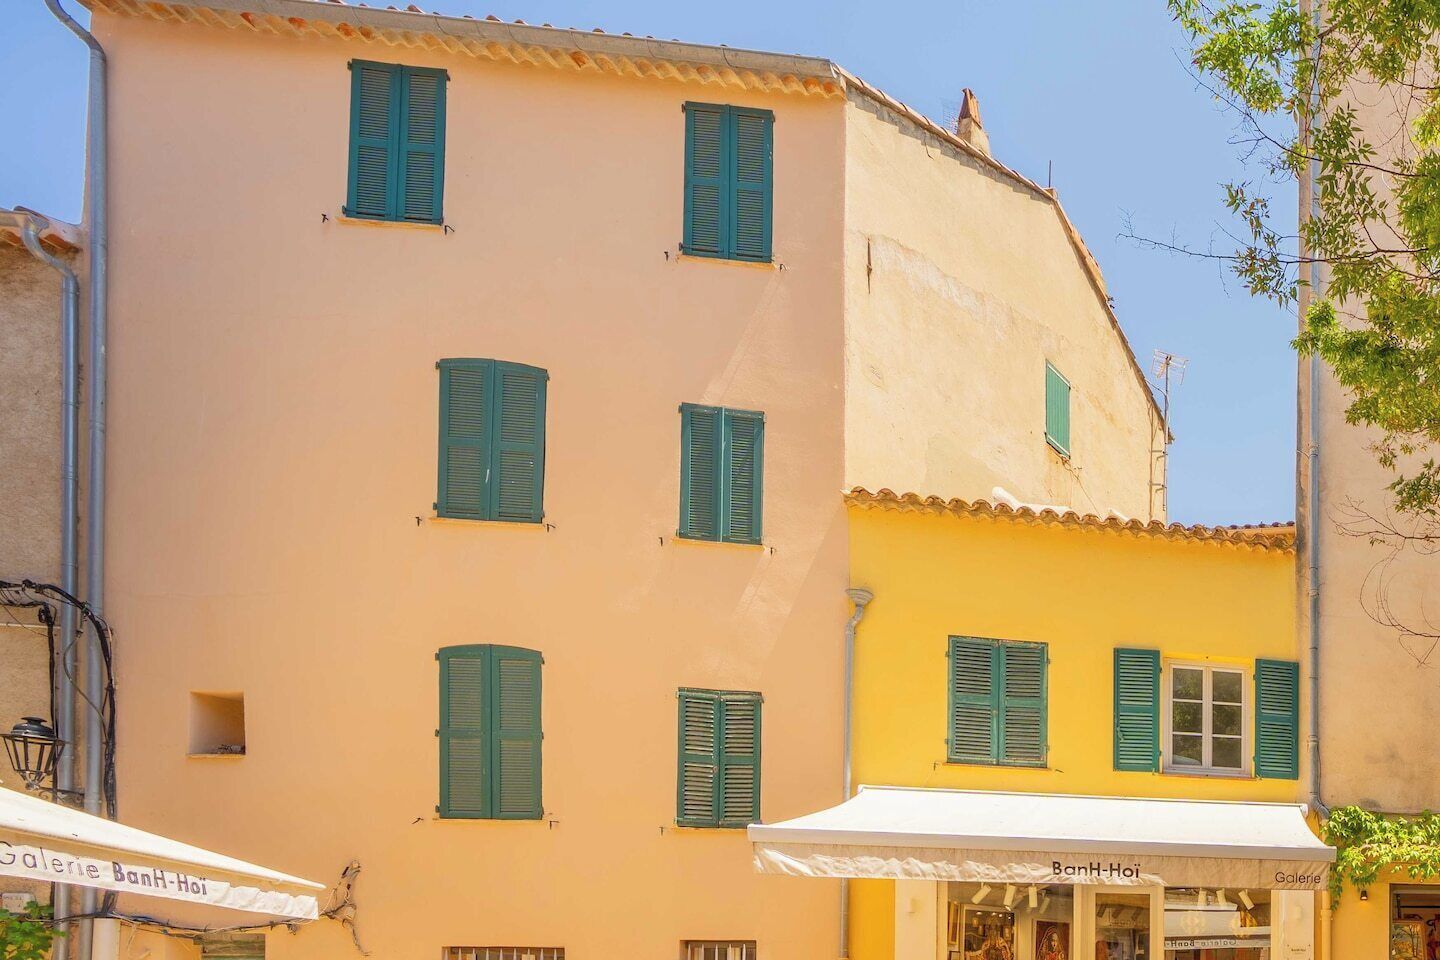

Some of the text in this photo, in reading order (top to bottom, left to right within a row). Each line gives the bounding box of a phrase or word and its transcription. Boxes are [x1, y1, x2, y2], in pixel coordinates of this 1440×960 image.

[0, 841, 208, 896] Galerie BanH-Hoï
[1052, 861, 1141, 878] BanH-Hoï
[1275, 871, 1321, 884] Galerie
